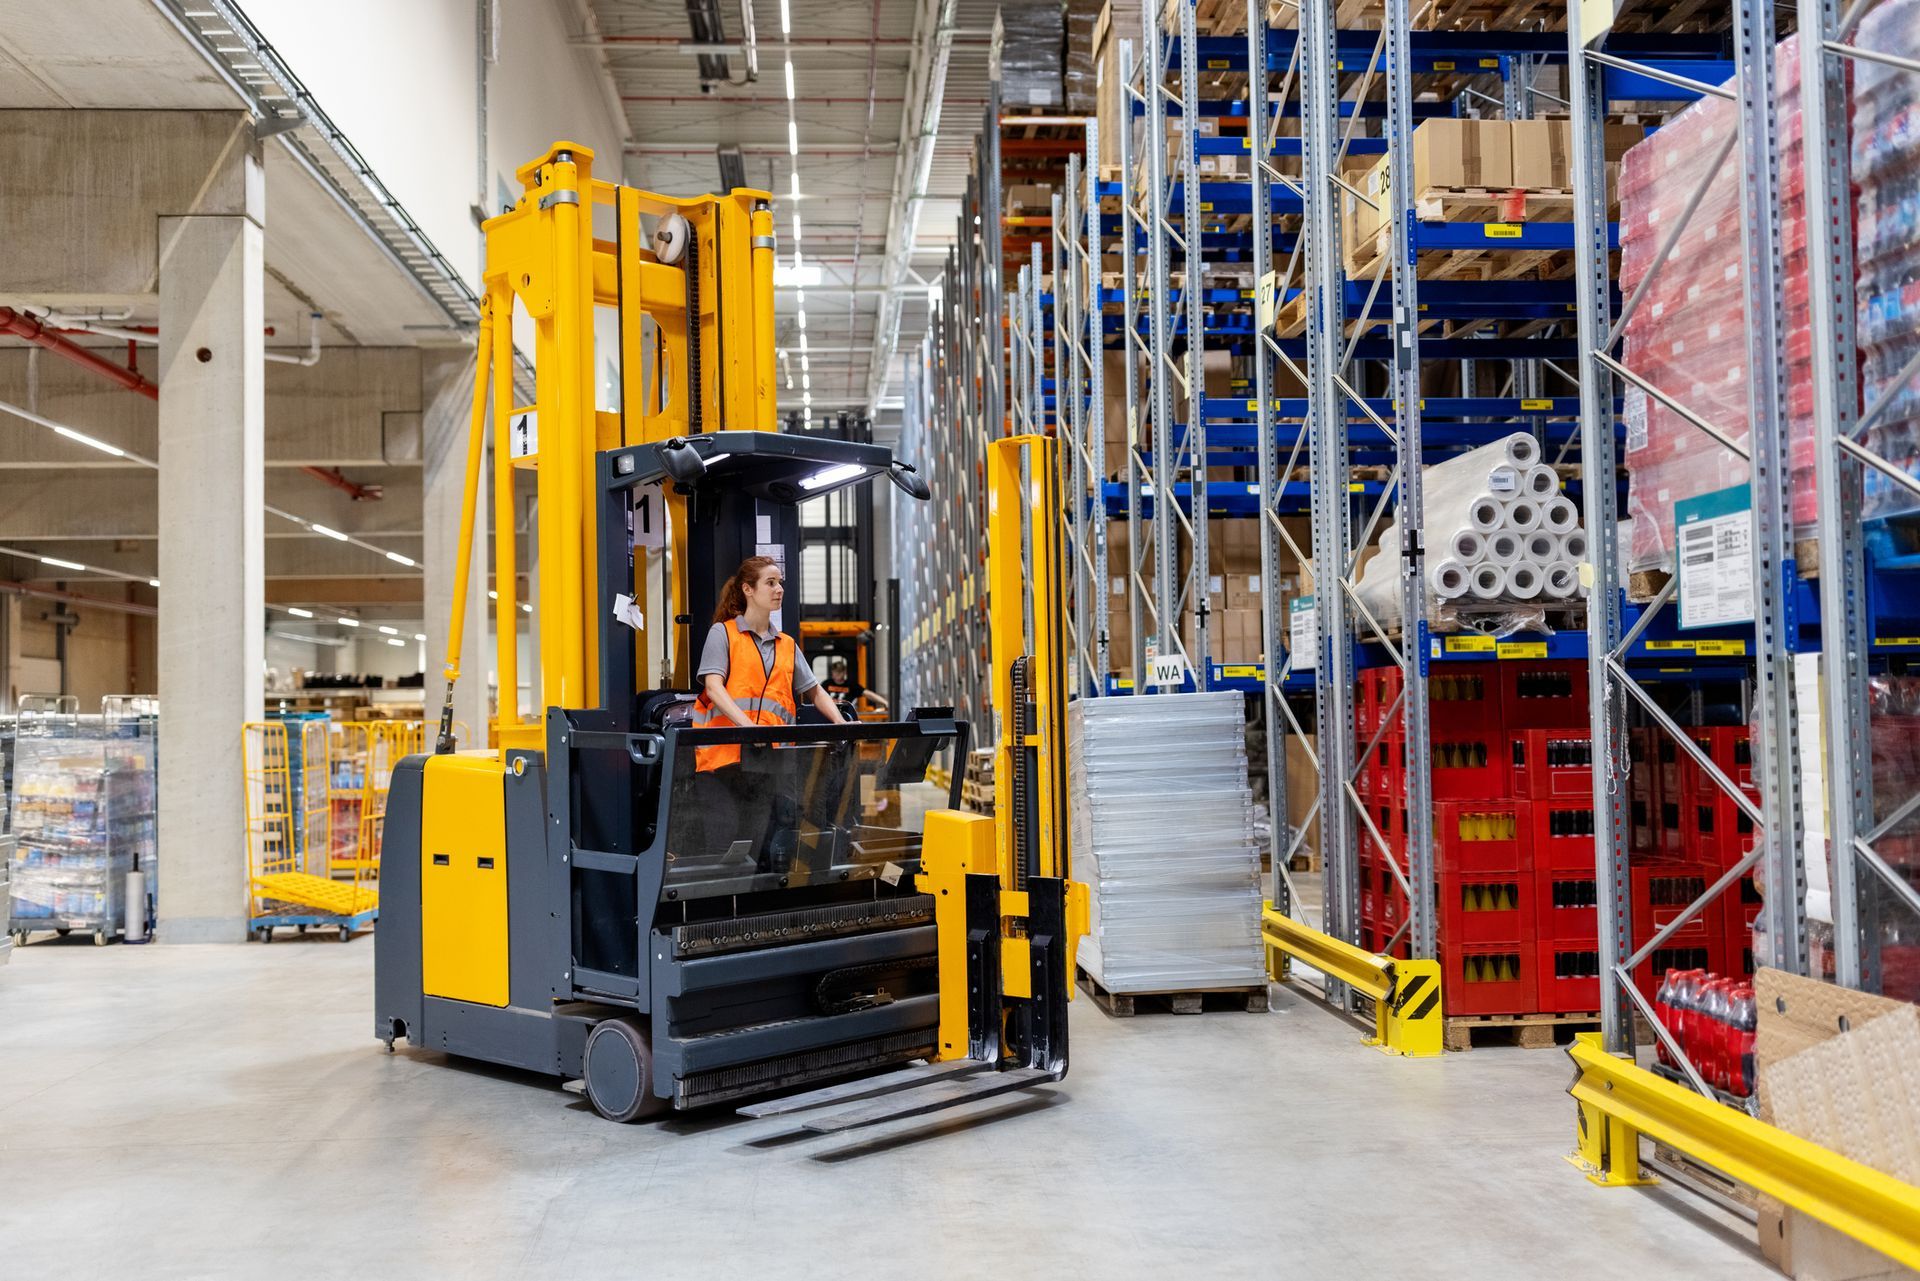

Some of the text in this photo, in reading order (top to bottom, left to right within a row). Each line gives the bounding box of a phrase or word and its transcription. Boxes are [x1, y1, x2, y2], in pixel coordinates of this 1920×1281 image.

[1380, 165, 1391, 196] 28
[1261, 282, 1272, 305] 27
[517, 414, 528, 455] 1
[635, 494, 650, 534] 1
[1156, 664, 1181, 681] WA
